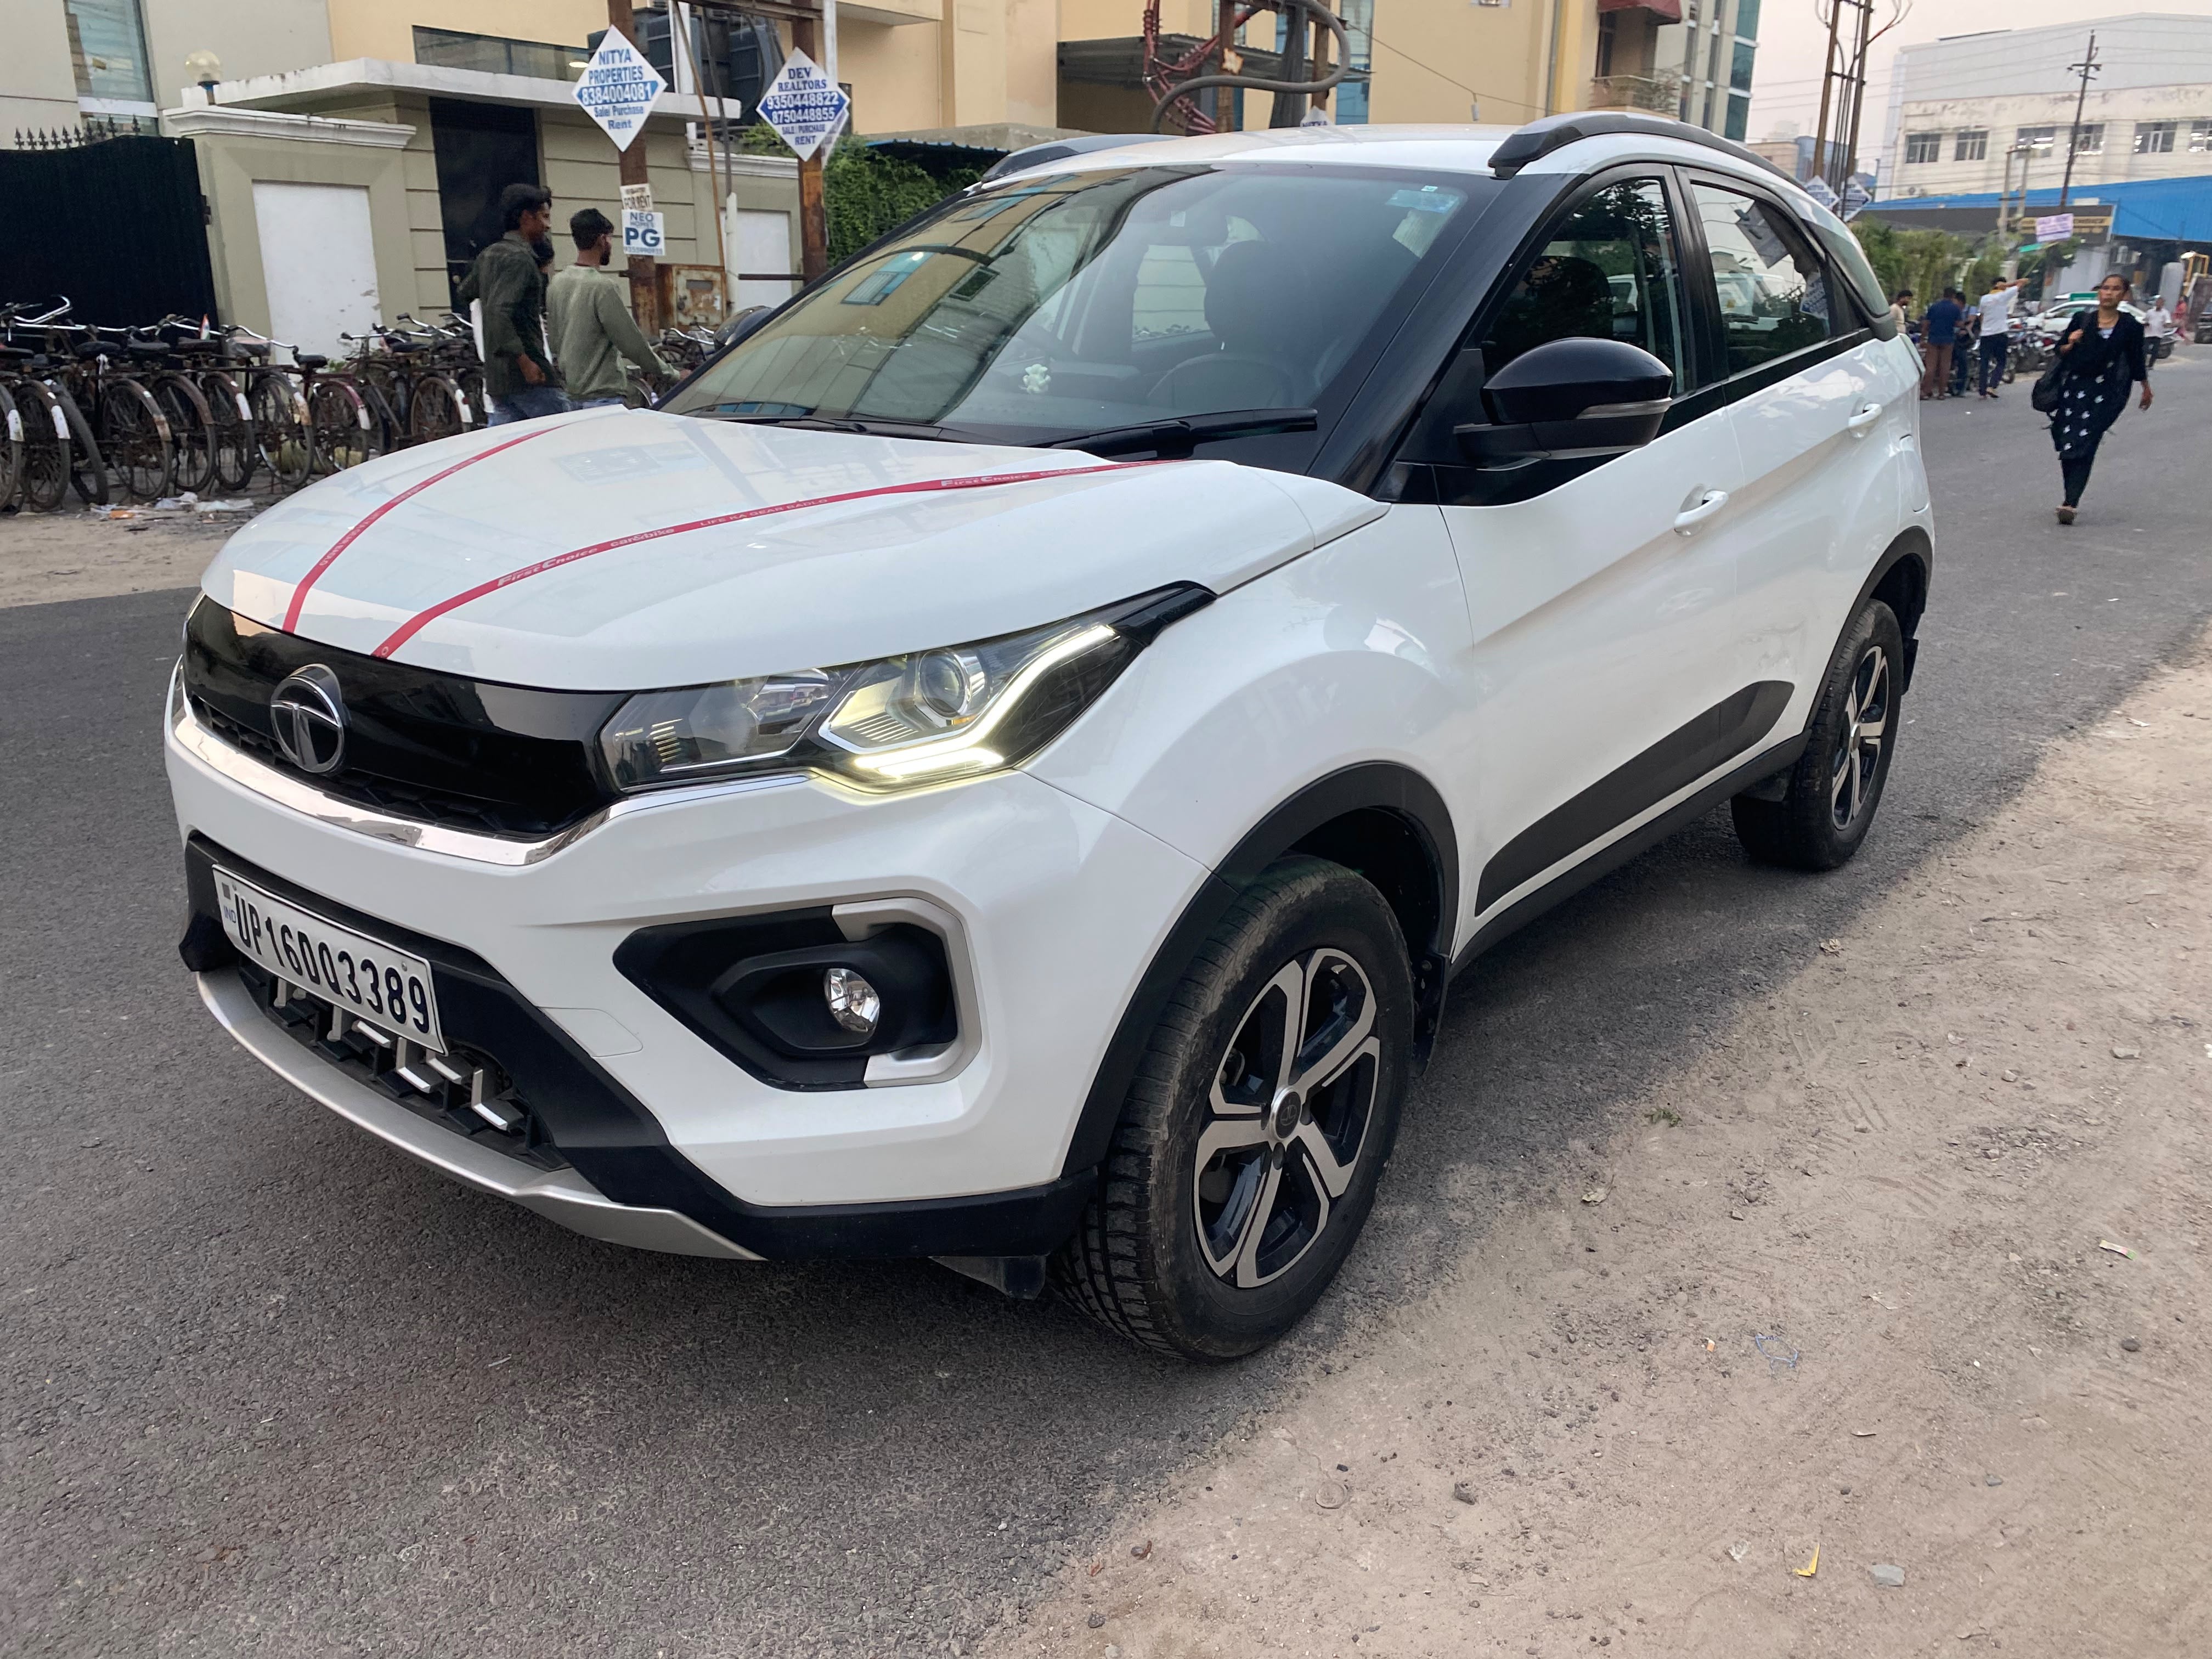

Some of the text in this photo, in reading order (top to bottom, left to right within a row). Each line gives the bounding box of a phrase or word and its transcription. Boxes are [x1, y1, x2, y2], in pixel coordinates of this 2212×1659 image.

[599, 49, 631, 65] NITYA
[589, 65, 643, 84] PROPERTIES
[788, 67, 812, 80] DEV
[582, 82, 652, 106] 8384004081
[778, 79, 827, 92] REALTORS
[766, 92, 839, 110] 9350448822
[771, 107, 836, 124] 8750448855
[608, 119, 632, 130] Rent
[794, 136, 816, 145] RENT
[630, 212, 654, 222] NEO
[625, 227, 660, 247] PG
[223, 905, 236, 923] IND
[234, 893, 430, 1034] UP16DQ3389
